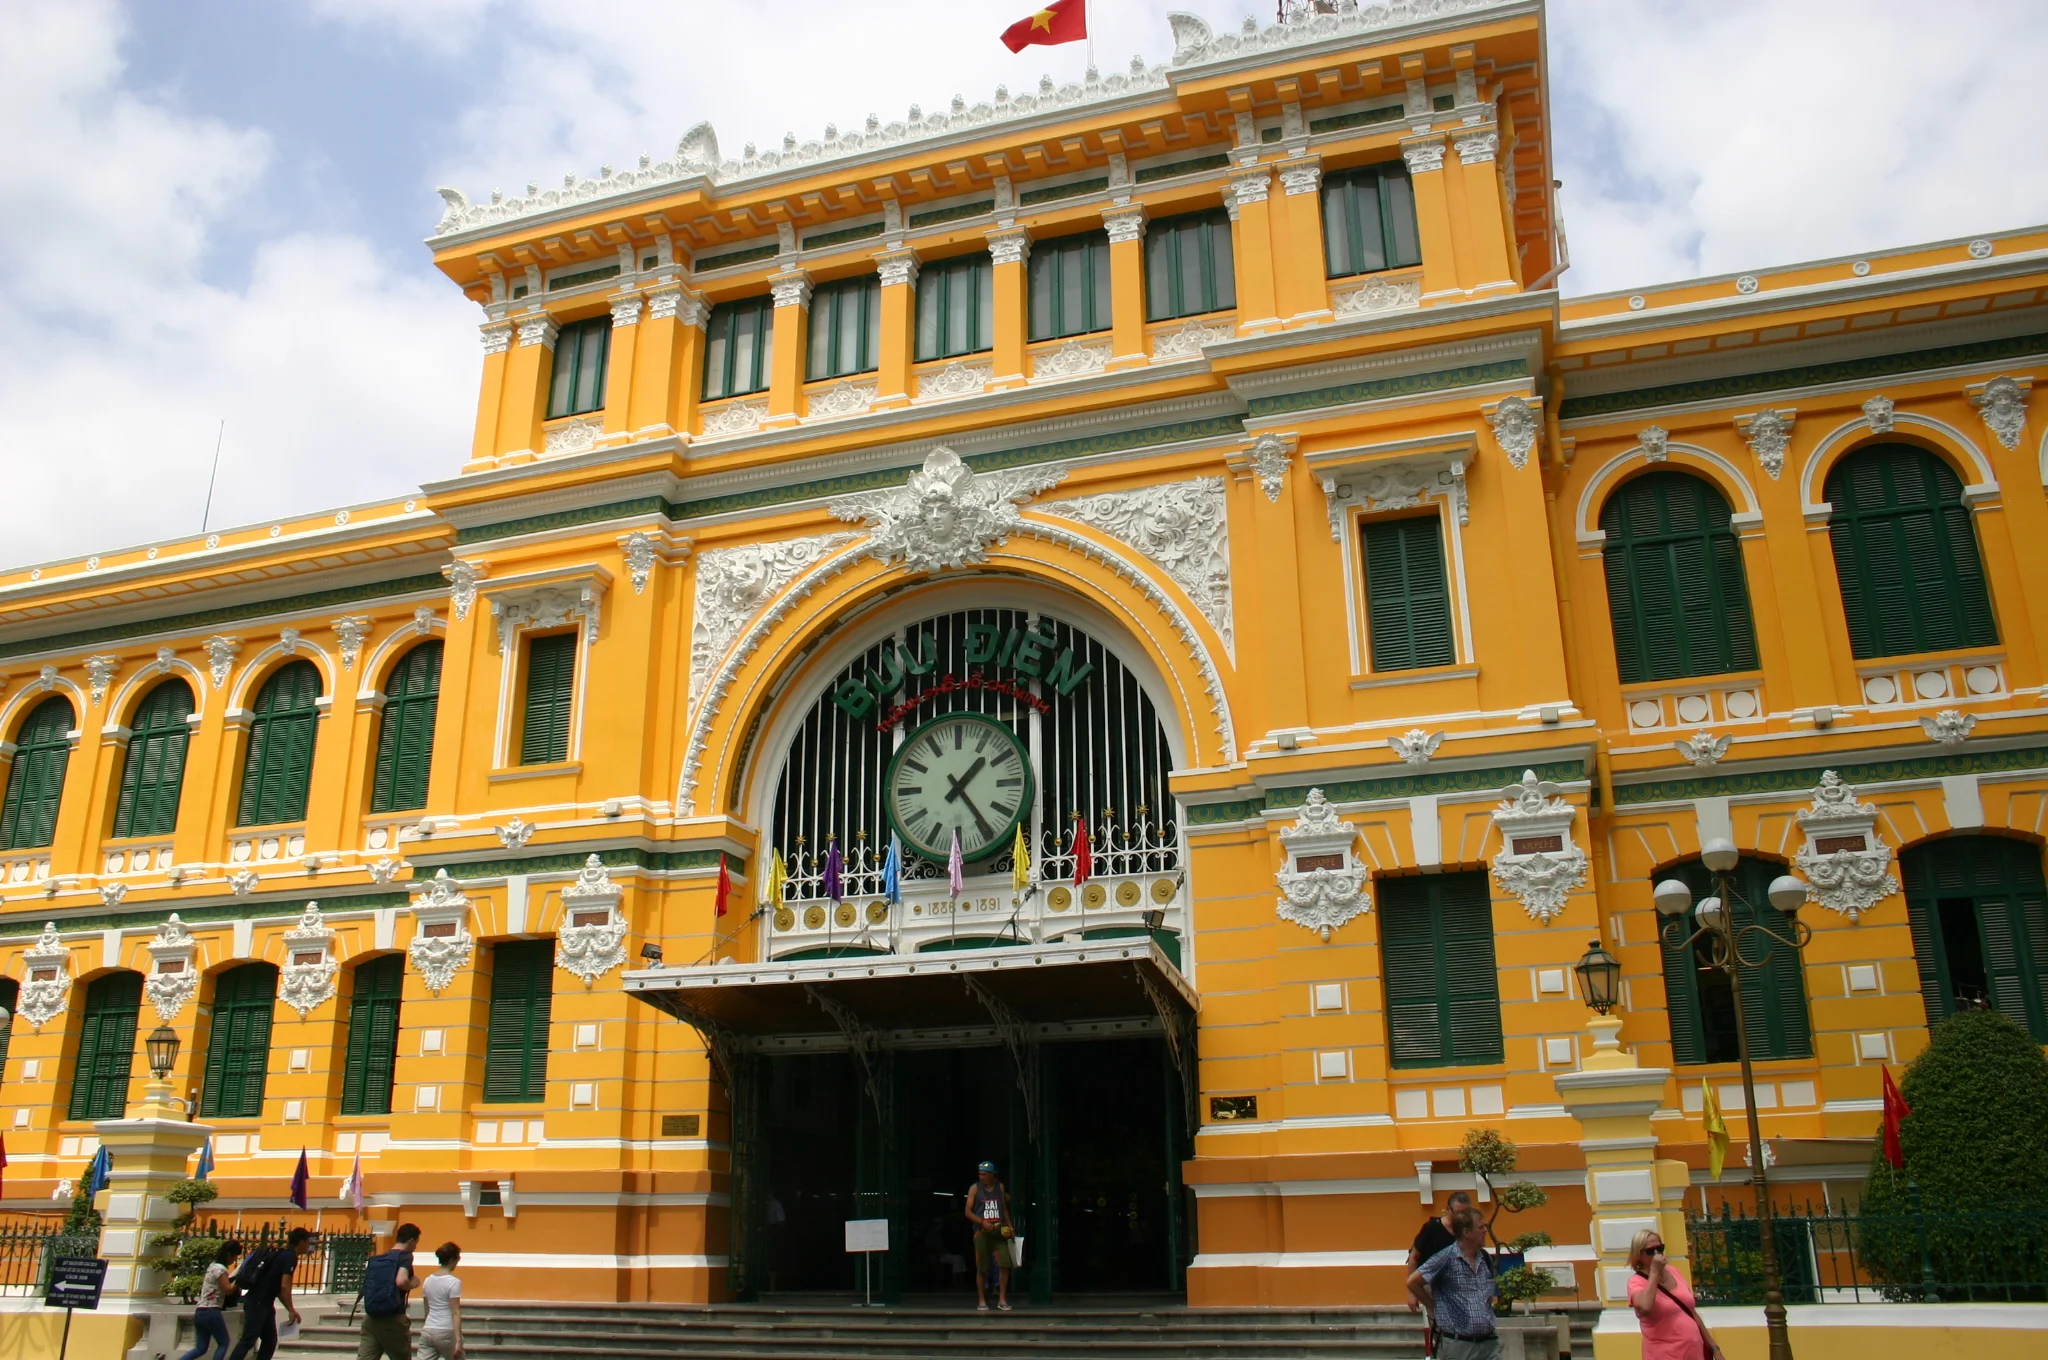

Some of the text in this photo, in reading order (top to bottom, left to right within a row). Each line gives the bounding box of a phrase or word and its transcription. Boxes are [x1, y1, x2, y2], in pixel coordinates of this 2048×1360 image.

[962, 622, 1095, 697] ĐIỆN
[922, 673, 955, 698] PHỐ
[960, 669, 983, 689] HỒ
[986, 677, 1018, 695] CHÍ
[1013, 687, 1051, 715] MINH
[928, 897, 1000, 915] 1886 1891
